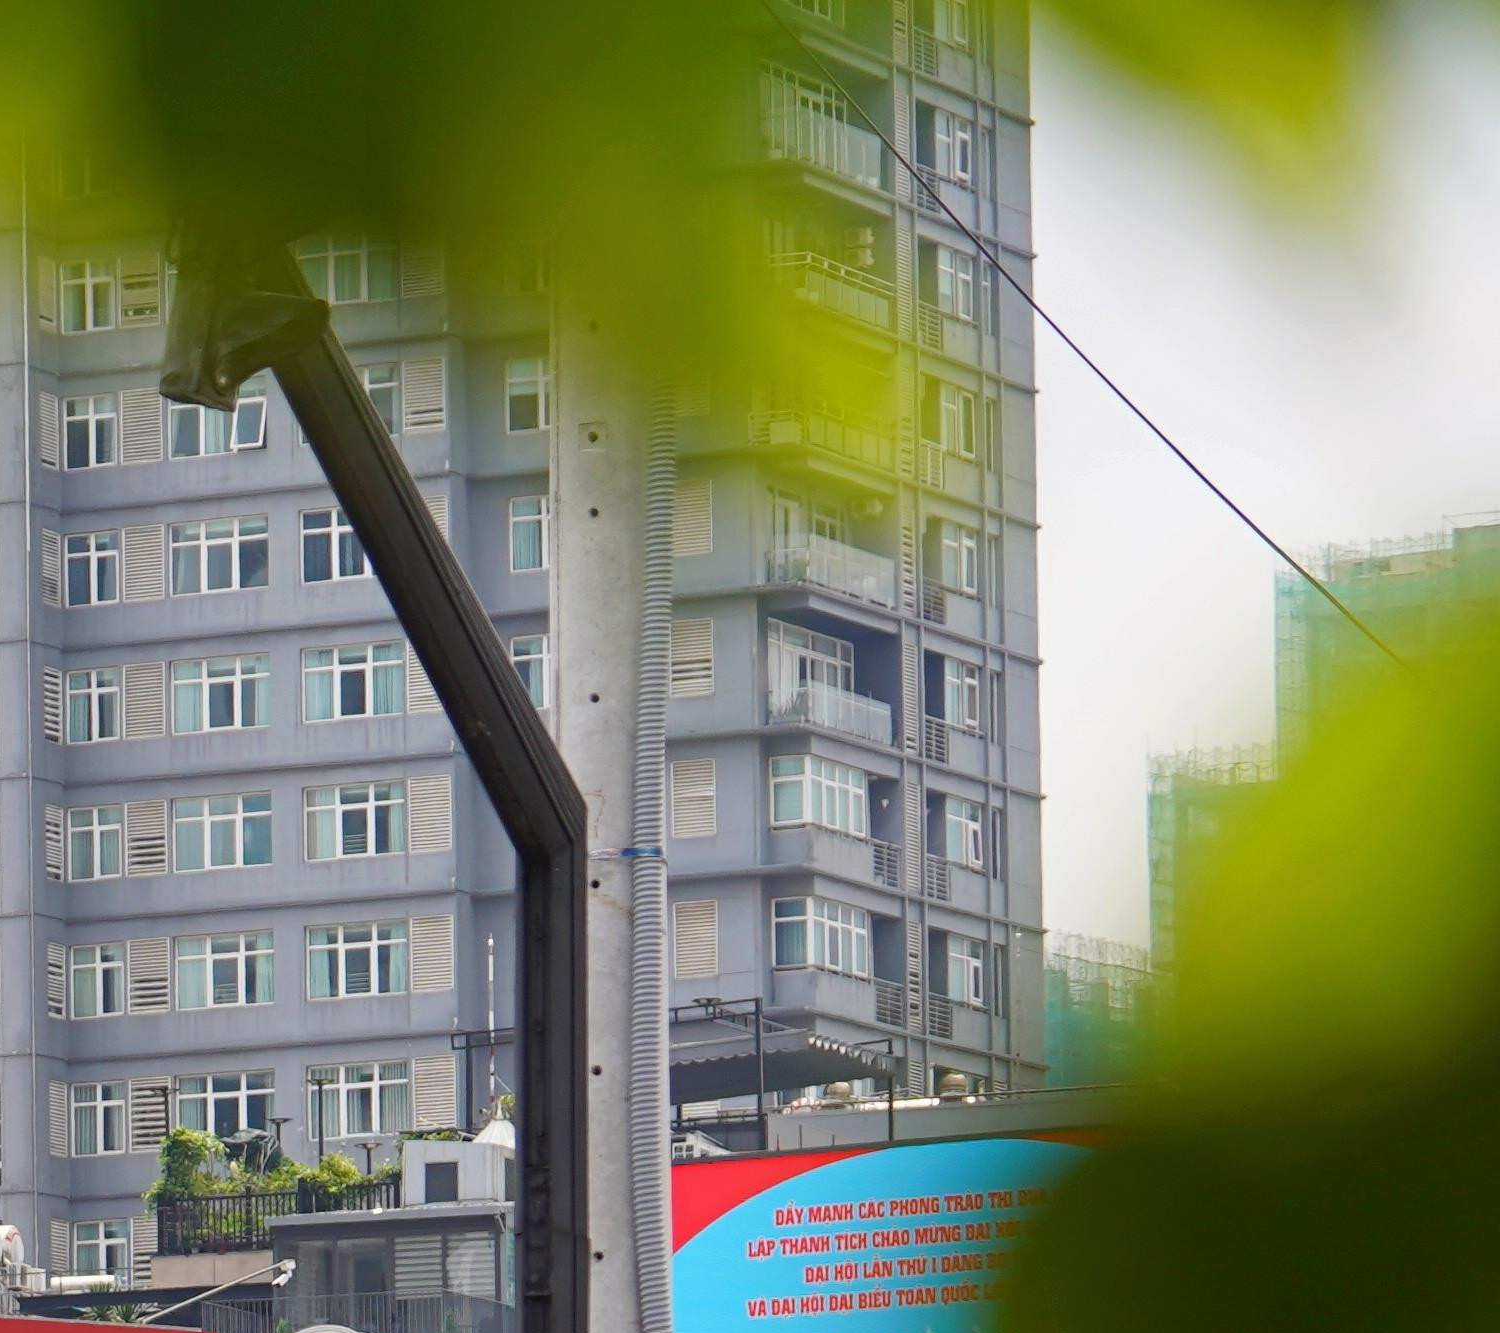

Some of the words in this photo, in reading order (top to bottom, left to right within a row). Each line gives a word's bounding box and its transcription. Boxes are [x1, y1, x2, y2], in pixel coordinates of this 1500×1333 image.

[808, 1206, 853, 1226] MẠNH
[858, 1199, 885, 1219] CÁC
[889, 1195, 939, 1217] PHONG
[944, 1191, 983, 1212] TRÀO
[748, 1235, 775, 1261] LẬP
[780, 1233, 831, 1255] THÀNH
[834, 1230, 867, 1250] TÍCH
[872, 1226, 909, 1248] CHÀO
[915, 1222, 960, 1245] MỪNG
[805, 1265, 829, 1287] ĐẠI
[834, 1258, 858, 1284] HỘI
[748, 1296, 766, 1317] VÀ
[771, 1298, 795, 1319] ĐẠI
[800, 1292, 824, 1316] HỘI
[829, 1292, 853, 1314] ĐẠI
[858, 1283, 891, 1310] BIỂU
[896, 1284, 936, 1306] TOÀN
